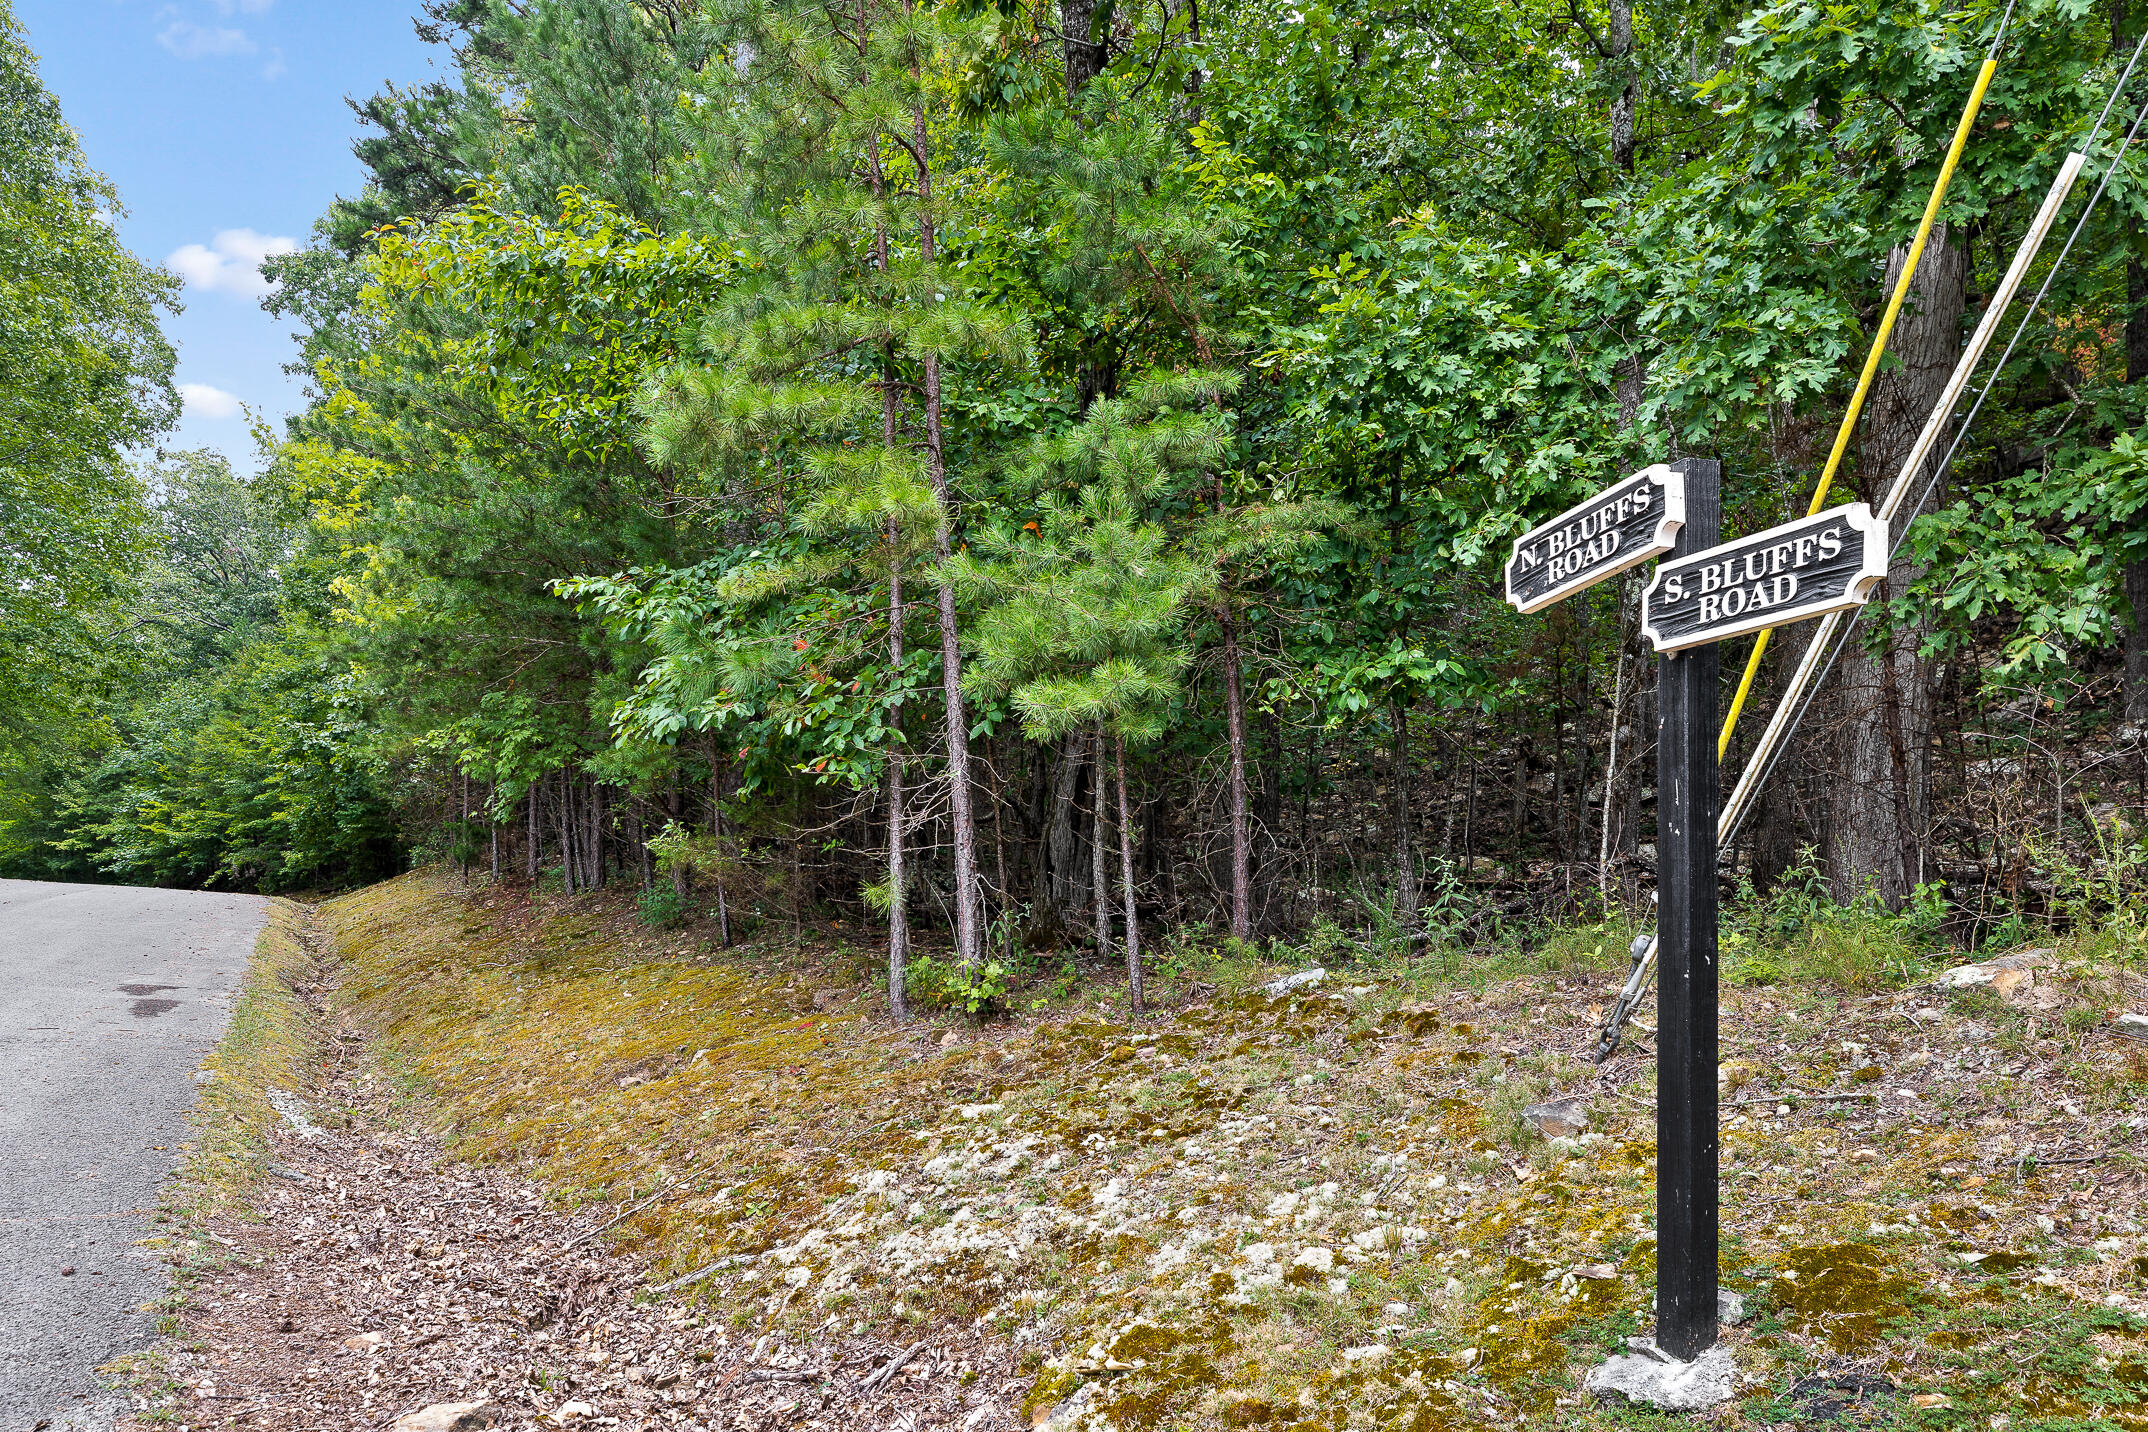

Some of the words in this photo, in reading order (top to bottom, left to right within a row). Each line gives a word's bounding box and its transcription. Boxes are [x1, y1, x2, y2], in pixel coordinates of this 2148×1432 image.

[1518, 548, 1544, 574] N.
[1548, 483, 1652, 552] BLUFFS
[1545, 530, 1621, 586] ROAD
[1664, 574, 1690, 605] S.
[1699, 526, 1842, 594] BLUFFS
[1698, 574, 1798, 625] ROAD
